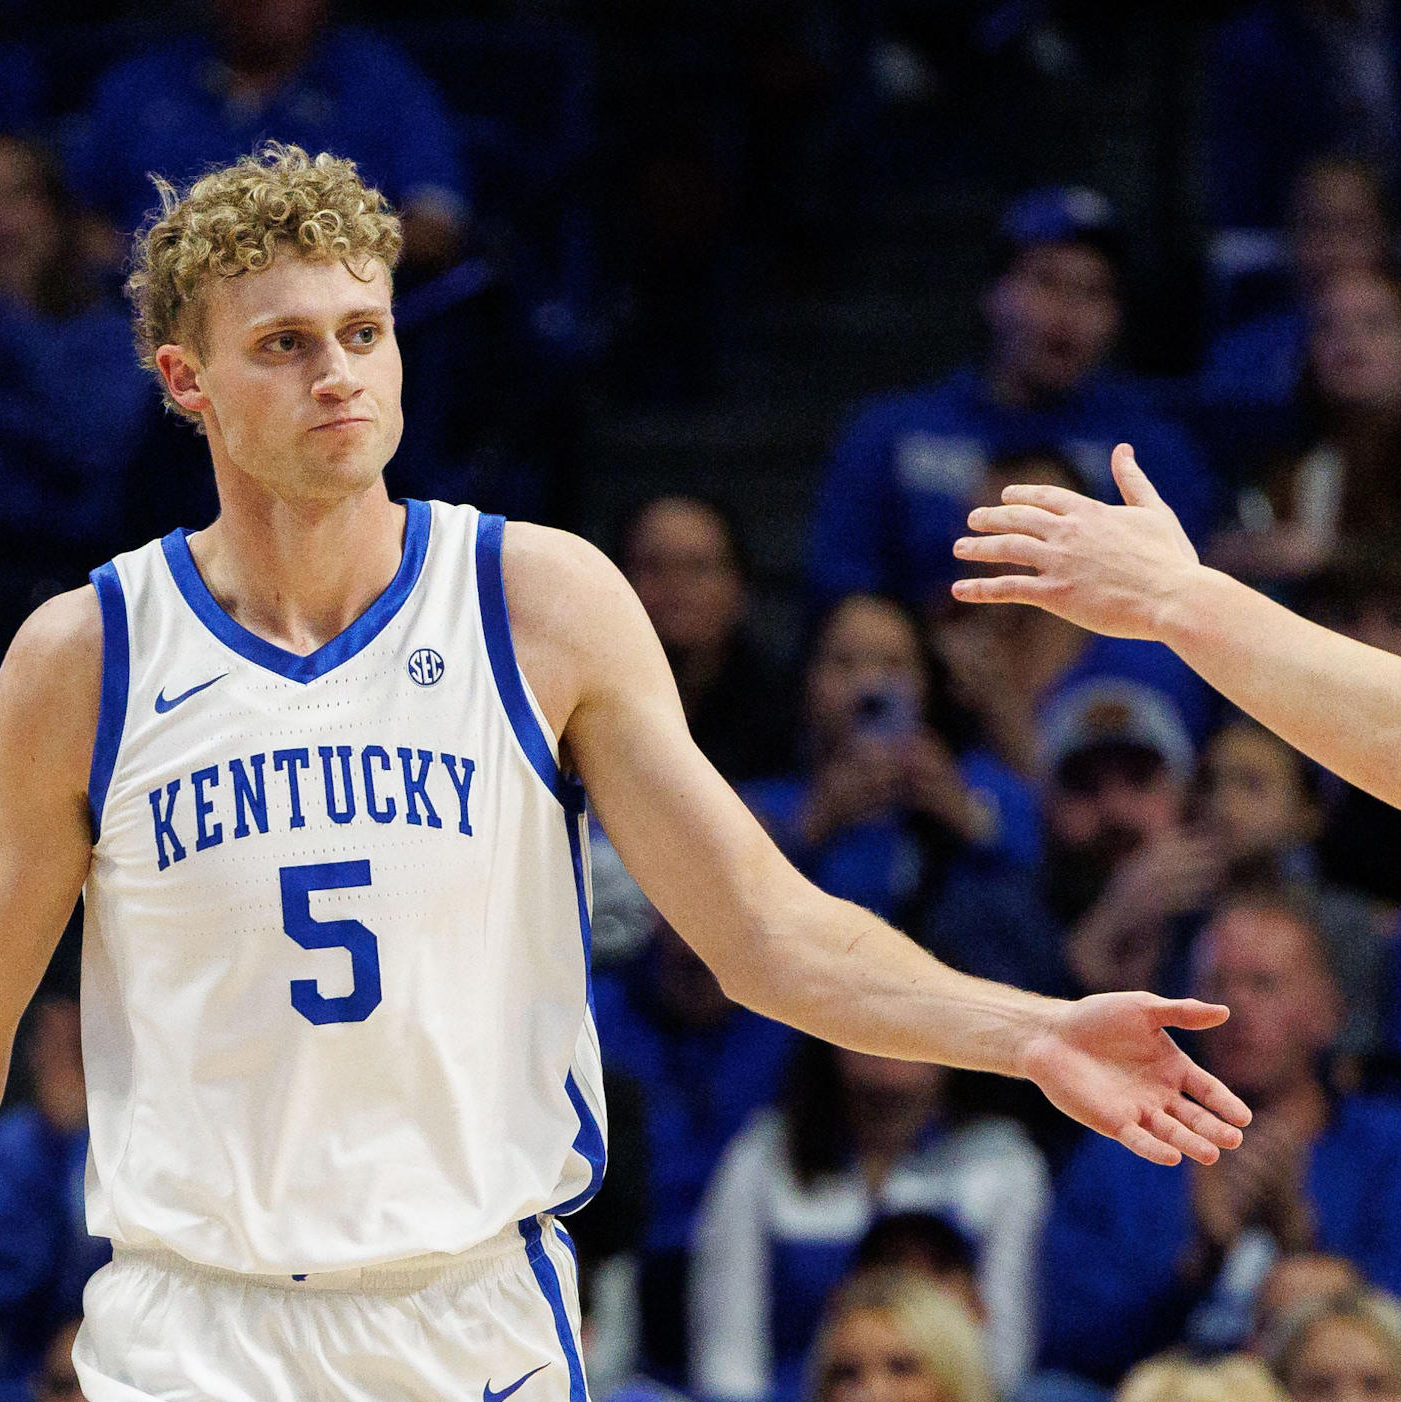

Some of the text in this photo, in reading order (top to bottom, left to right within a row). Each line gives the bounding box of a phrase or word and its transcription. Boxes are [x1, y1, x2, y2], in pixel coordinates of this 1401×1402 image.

[409, 650, 444, 684] SEC
[149, 745, 476, 871] KENTUCKY
[279, 859, 382, 1026] 5
